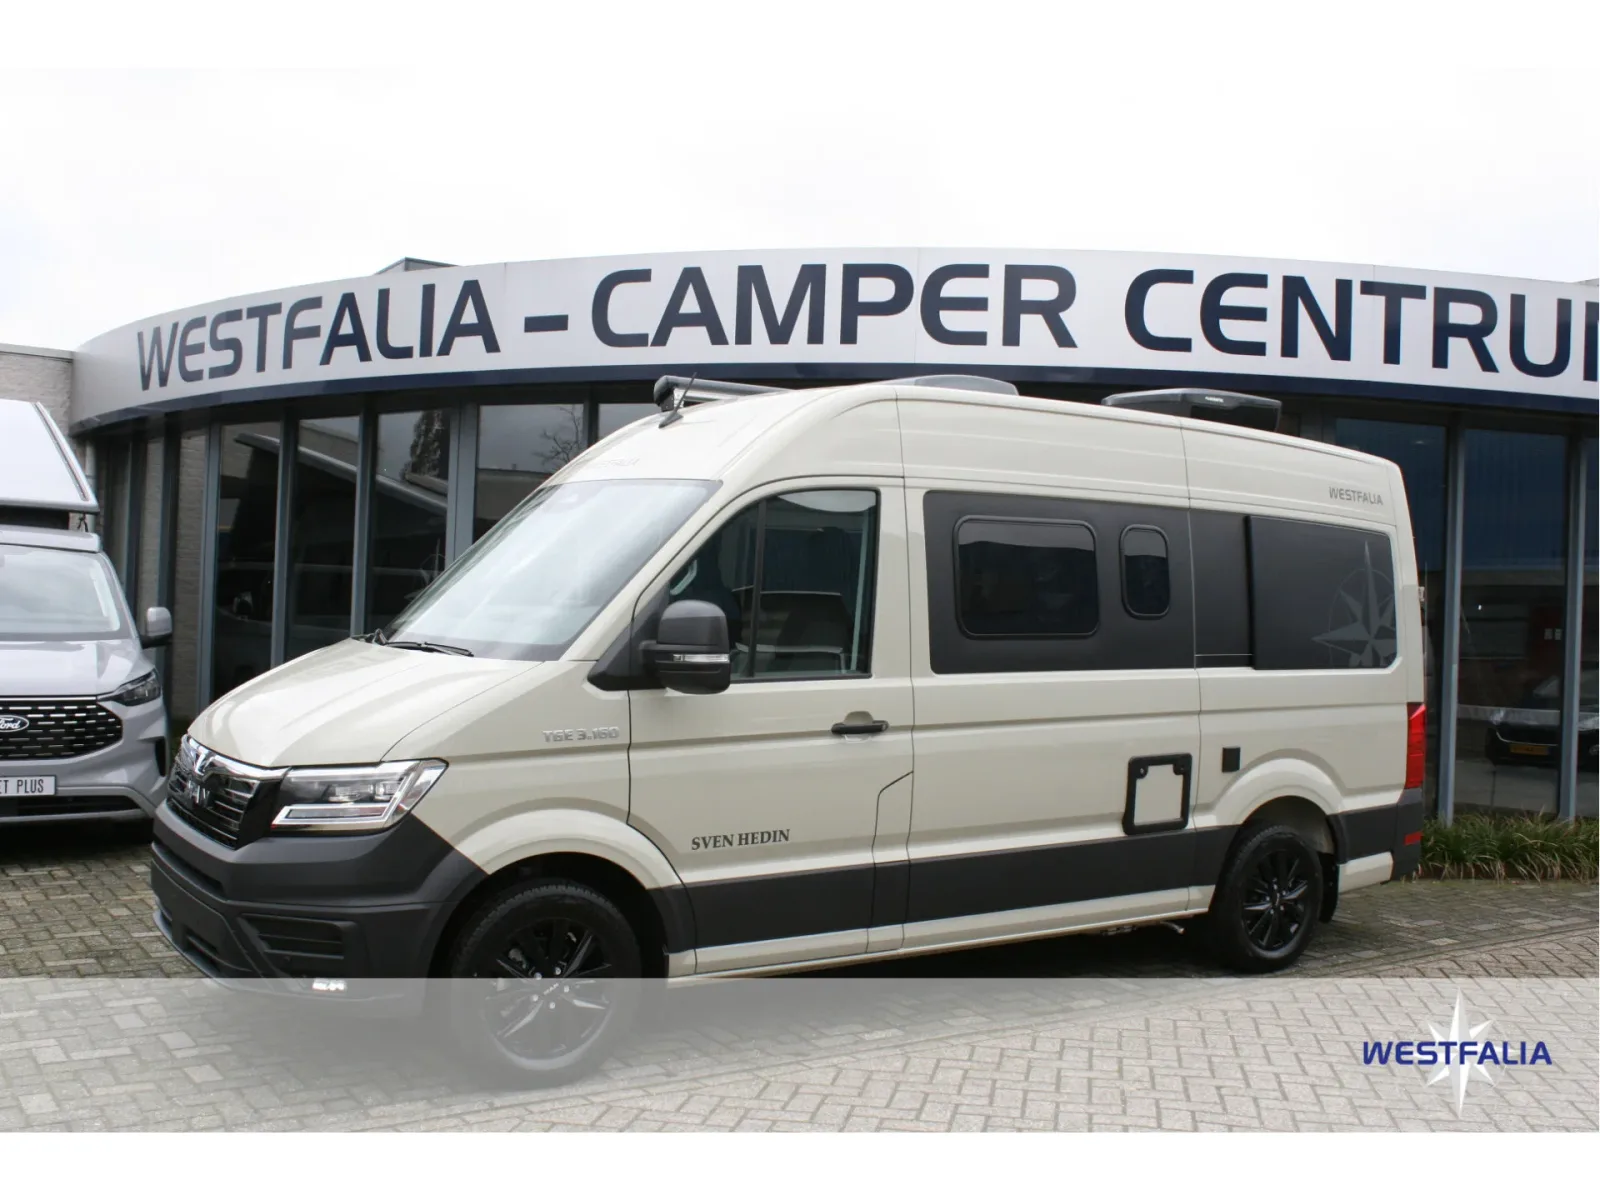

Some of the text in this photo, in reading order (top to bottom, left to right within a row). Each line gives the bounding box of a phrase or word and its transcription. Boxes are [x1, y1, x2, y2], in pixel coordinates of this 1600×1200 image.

[137, 278, 501, 391] WESTFALIA
[590, 263, 1079, 349] CAMPER
[1123, 268, 1599, 382] CENTRU
[1328, 486, 1384, 506] WESTFALIA
[16, 778, 44, 794] PLUS
[691, 828, 791, 851] SVEN HEDIN
